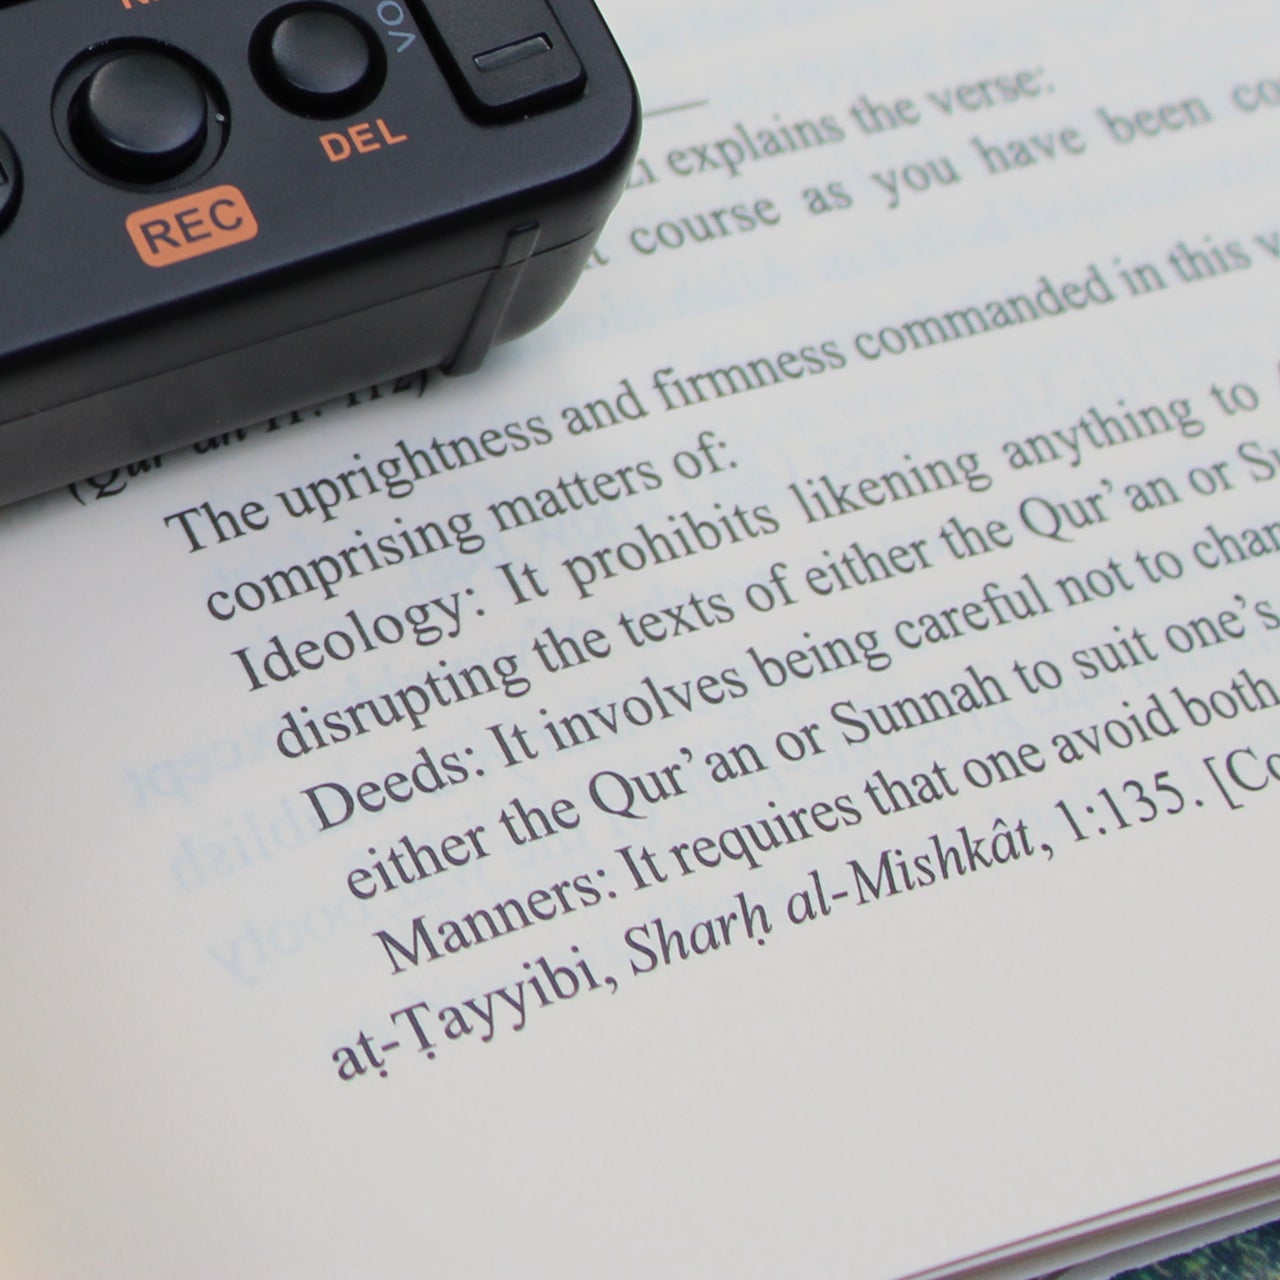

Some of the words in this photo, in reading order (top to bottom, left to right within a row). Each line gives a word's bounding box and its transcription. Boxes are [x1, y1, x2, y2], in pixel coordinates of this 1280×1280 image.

[319, 118, 408, 163] DEL
[628, 197, 782, 257] course
[800, 181, 855, 217] as
[869, 156, 963, 211] you
[969, 127, 1087, 176] have
[1095, 97, 1213, 144] been
[665, 115, 849, 180] explains
[846, 92, 924, 138] the
[924, 60, 1055, 120] verse:
[140, 197, 244, 255] REC
[161, 500, 271, 555] The
[273, 415, 554, 524] uprightness
[560, 377, 650, 437] and
[652, 341, 847, 412] firmness
[853, 264, 1115, 362] commanded
[1118, 251, 1168, 299] in
[1168, 232, 1253, 286] this
[205, 511, 487, 623] comprising
[486, 460, 664, 533] matters
[672, 430, 740, 482] of:
[229, 587, 488, 693] Ideology:
[494, 561, 550, 606] It
[560, 502, 781, 601] prohibits
[787, 452, 993, 525] likening
[1001, 399, 1205, 471] anything
[1208, 382, 1261, 418] to
[298, 745, 486, 833] Deeds:
[484, 722, 540, 769] It
[542, 666, 750, 753] involves
[744, 629, 893, 689] being
[893, 572, 1053, 651] careful
[1054, 558, 1135, 608] not
[1134, 550, 1185, 585] to
[346, 824, 492, 902] either
[497, 796, 582, 847] the
[774, 722, 827, 763] or
[829, 664, 1013, 747] Sunnah
[1011, 659, 1064, 695] to
[1070, 627, 1160, 681] suit
[371, 867, 618, 977] Manners:
[613, 844, 670, 892] It
[667, 793, 864, 878] requires
[862, 759, 961, 817] that
[962, 742, 1047, 790] one
[1049, 692, 1181, 765] avoid
[1169, 667, 1280, 728] both
[1053, 769, 1205, 843] 1:135.
